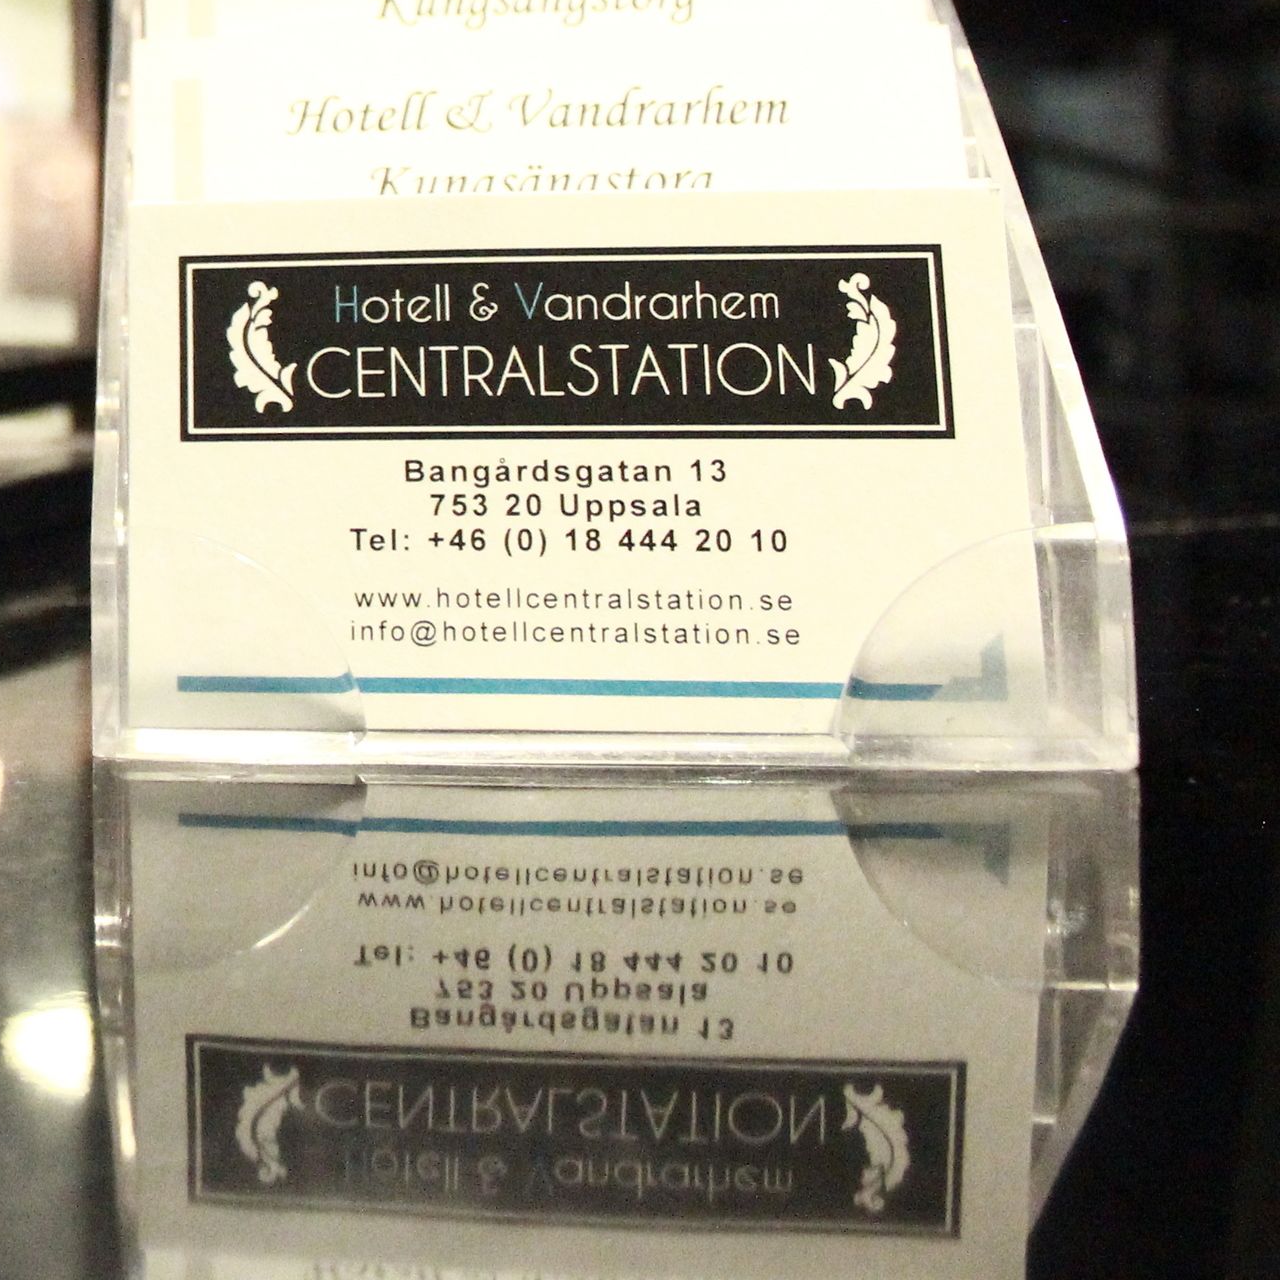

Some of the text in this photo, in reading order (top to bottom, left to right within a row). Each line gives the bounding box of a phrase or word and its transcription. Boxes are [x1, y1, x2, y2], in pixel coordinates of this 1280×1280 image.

[288, 84, 789, 135] Hotell & Vandrarhem
[334, 279, 781, 325] Hotell & Vandrarhem
[305, 342, 817, 400] CENTRALSTATION
[403, 457, 728, 489] Bangårdsgatan 13
[429, 492, 703, 523] 753 20 Uppsala
[349, 527, 789, 558] Tel: +46 (0) 18 444 20 10
[353, 587, 794, 613] www.hotellcentralstation.se
[350, 619, 802, 649] info@hotellcentralstation.se
